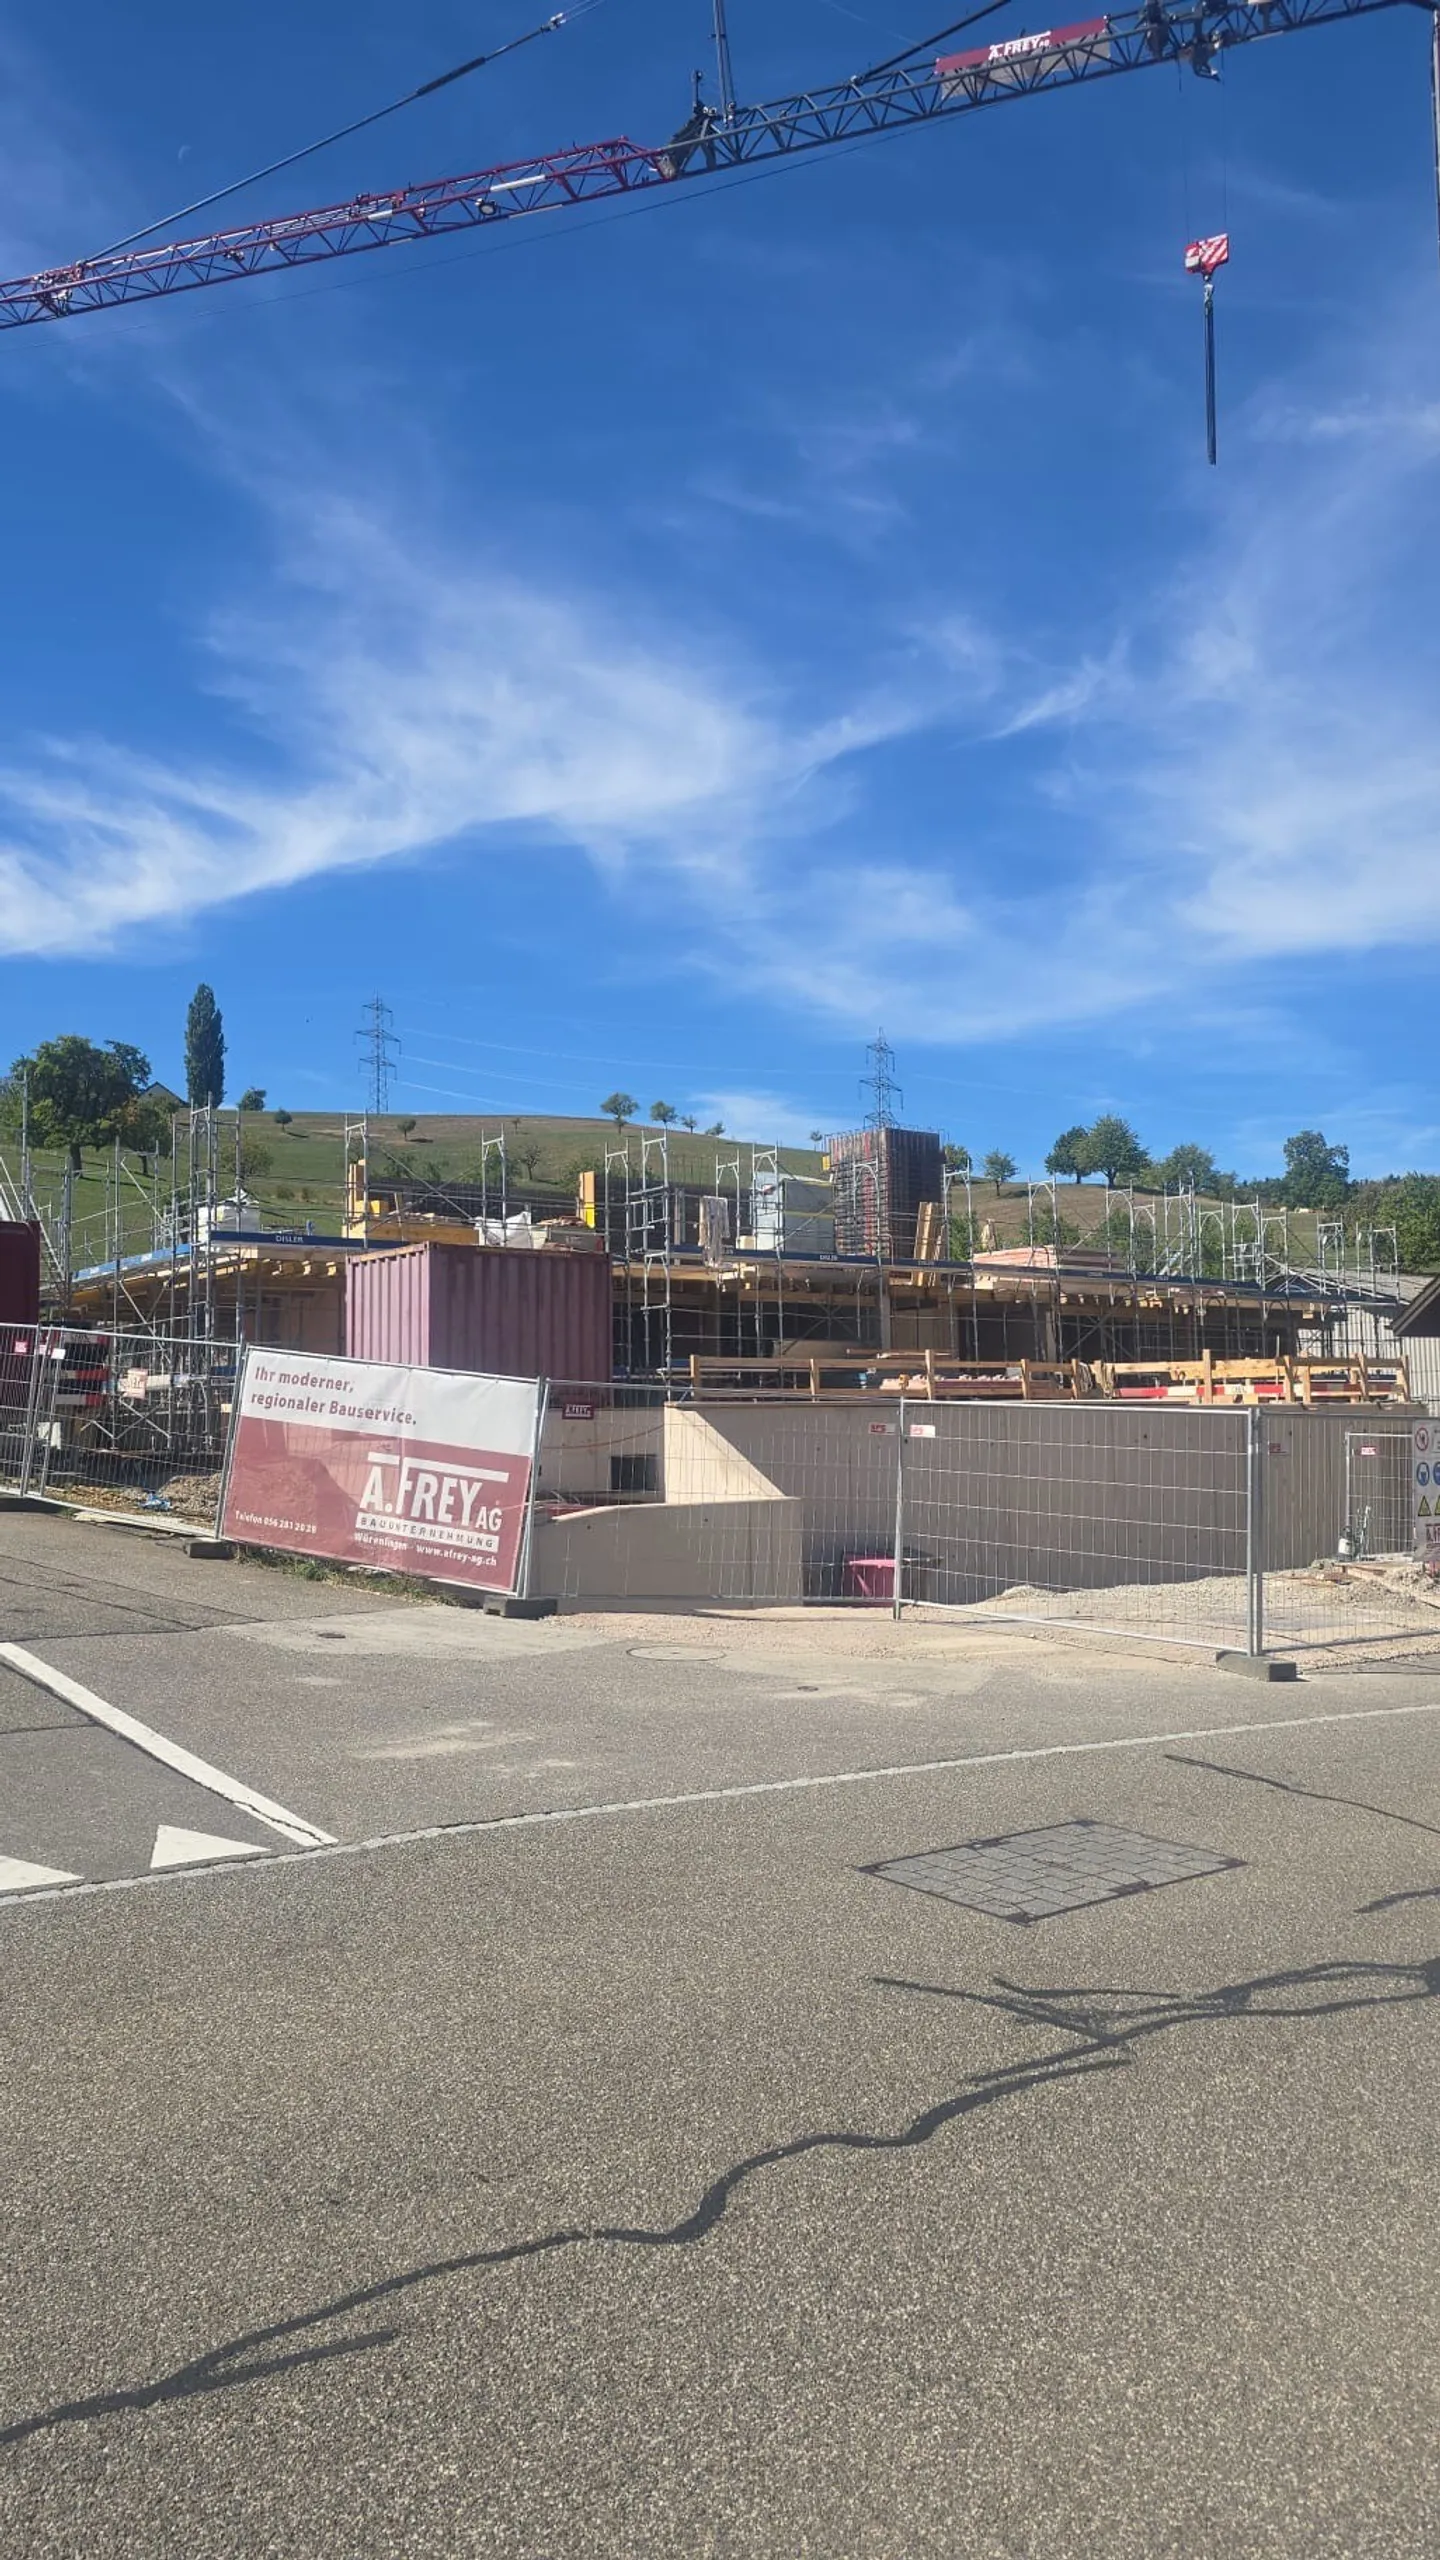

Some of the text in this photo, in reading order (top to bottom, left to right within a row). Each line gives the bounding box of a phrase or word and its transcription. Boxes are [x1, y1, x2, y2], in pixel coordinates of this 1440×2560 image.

[255, 1366, 354, 1394] Ihr moderner,
[250, 1392, 417, 1426] regionaler Bauservice.
[359, 1457, 503, 1532] A.FREY AG
[235, 1510, 262, 1524] Telefon
[360, 1516, 494, 1548] BAUUNTERNEHMUNG
[416, 1544, 497, 1567] www.afrey-ag.ch
